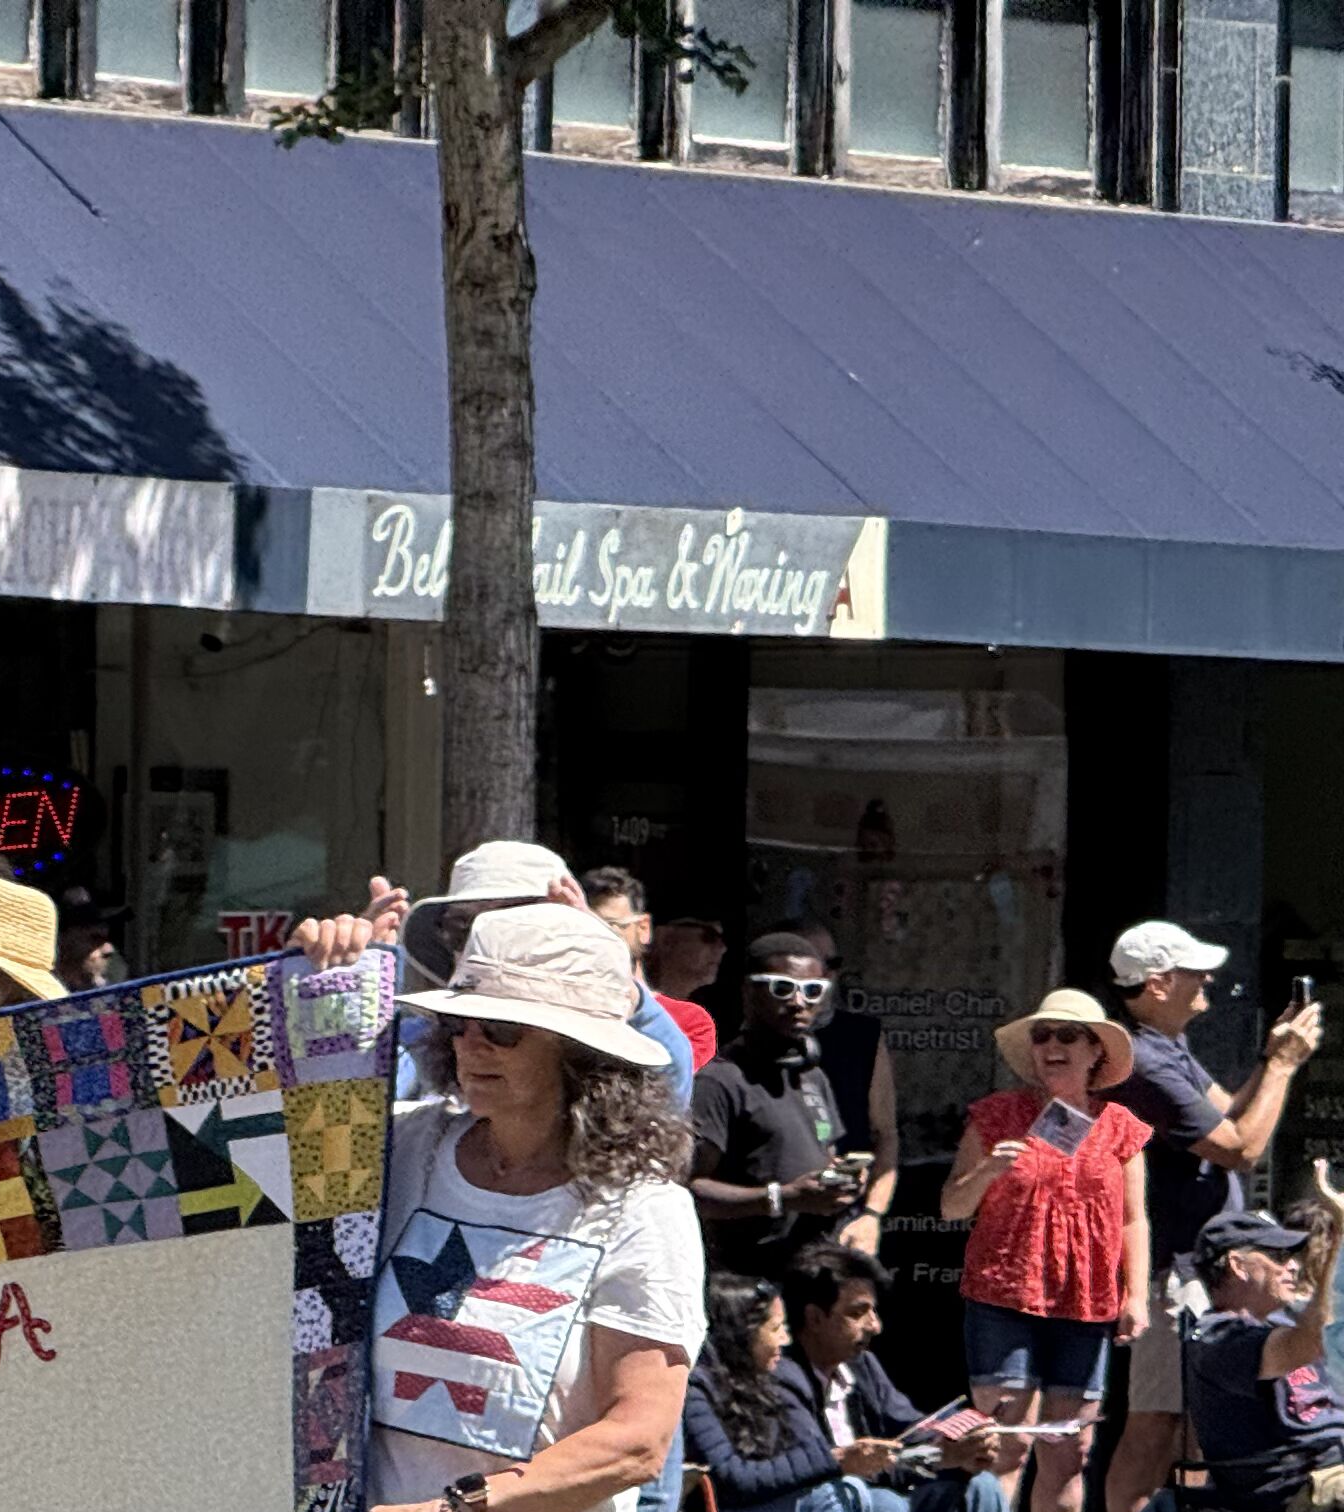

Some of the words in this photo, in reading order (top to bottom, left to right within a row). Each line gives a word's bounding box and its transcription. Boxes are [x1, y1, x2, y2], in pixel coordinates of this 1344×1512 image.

[532, 517, 587, 609] ail
[587, 528, 661, 624] Spa
[666, 523, 703, 612] &
[611, 815, 650, 847] 1409
[846, 988, 932, 1014] Daniel
[944, 991, 1006, 1016] Chin
